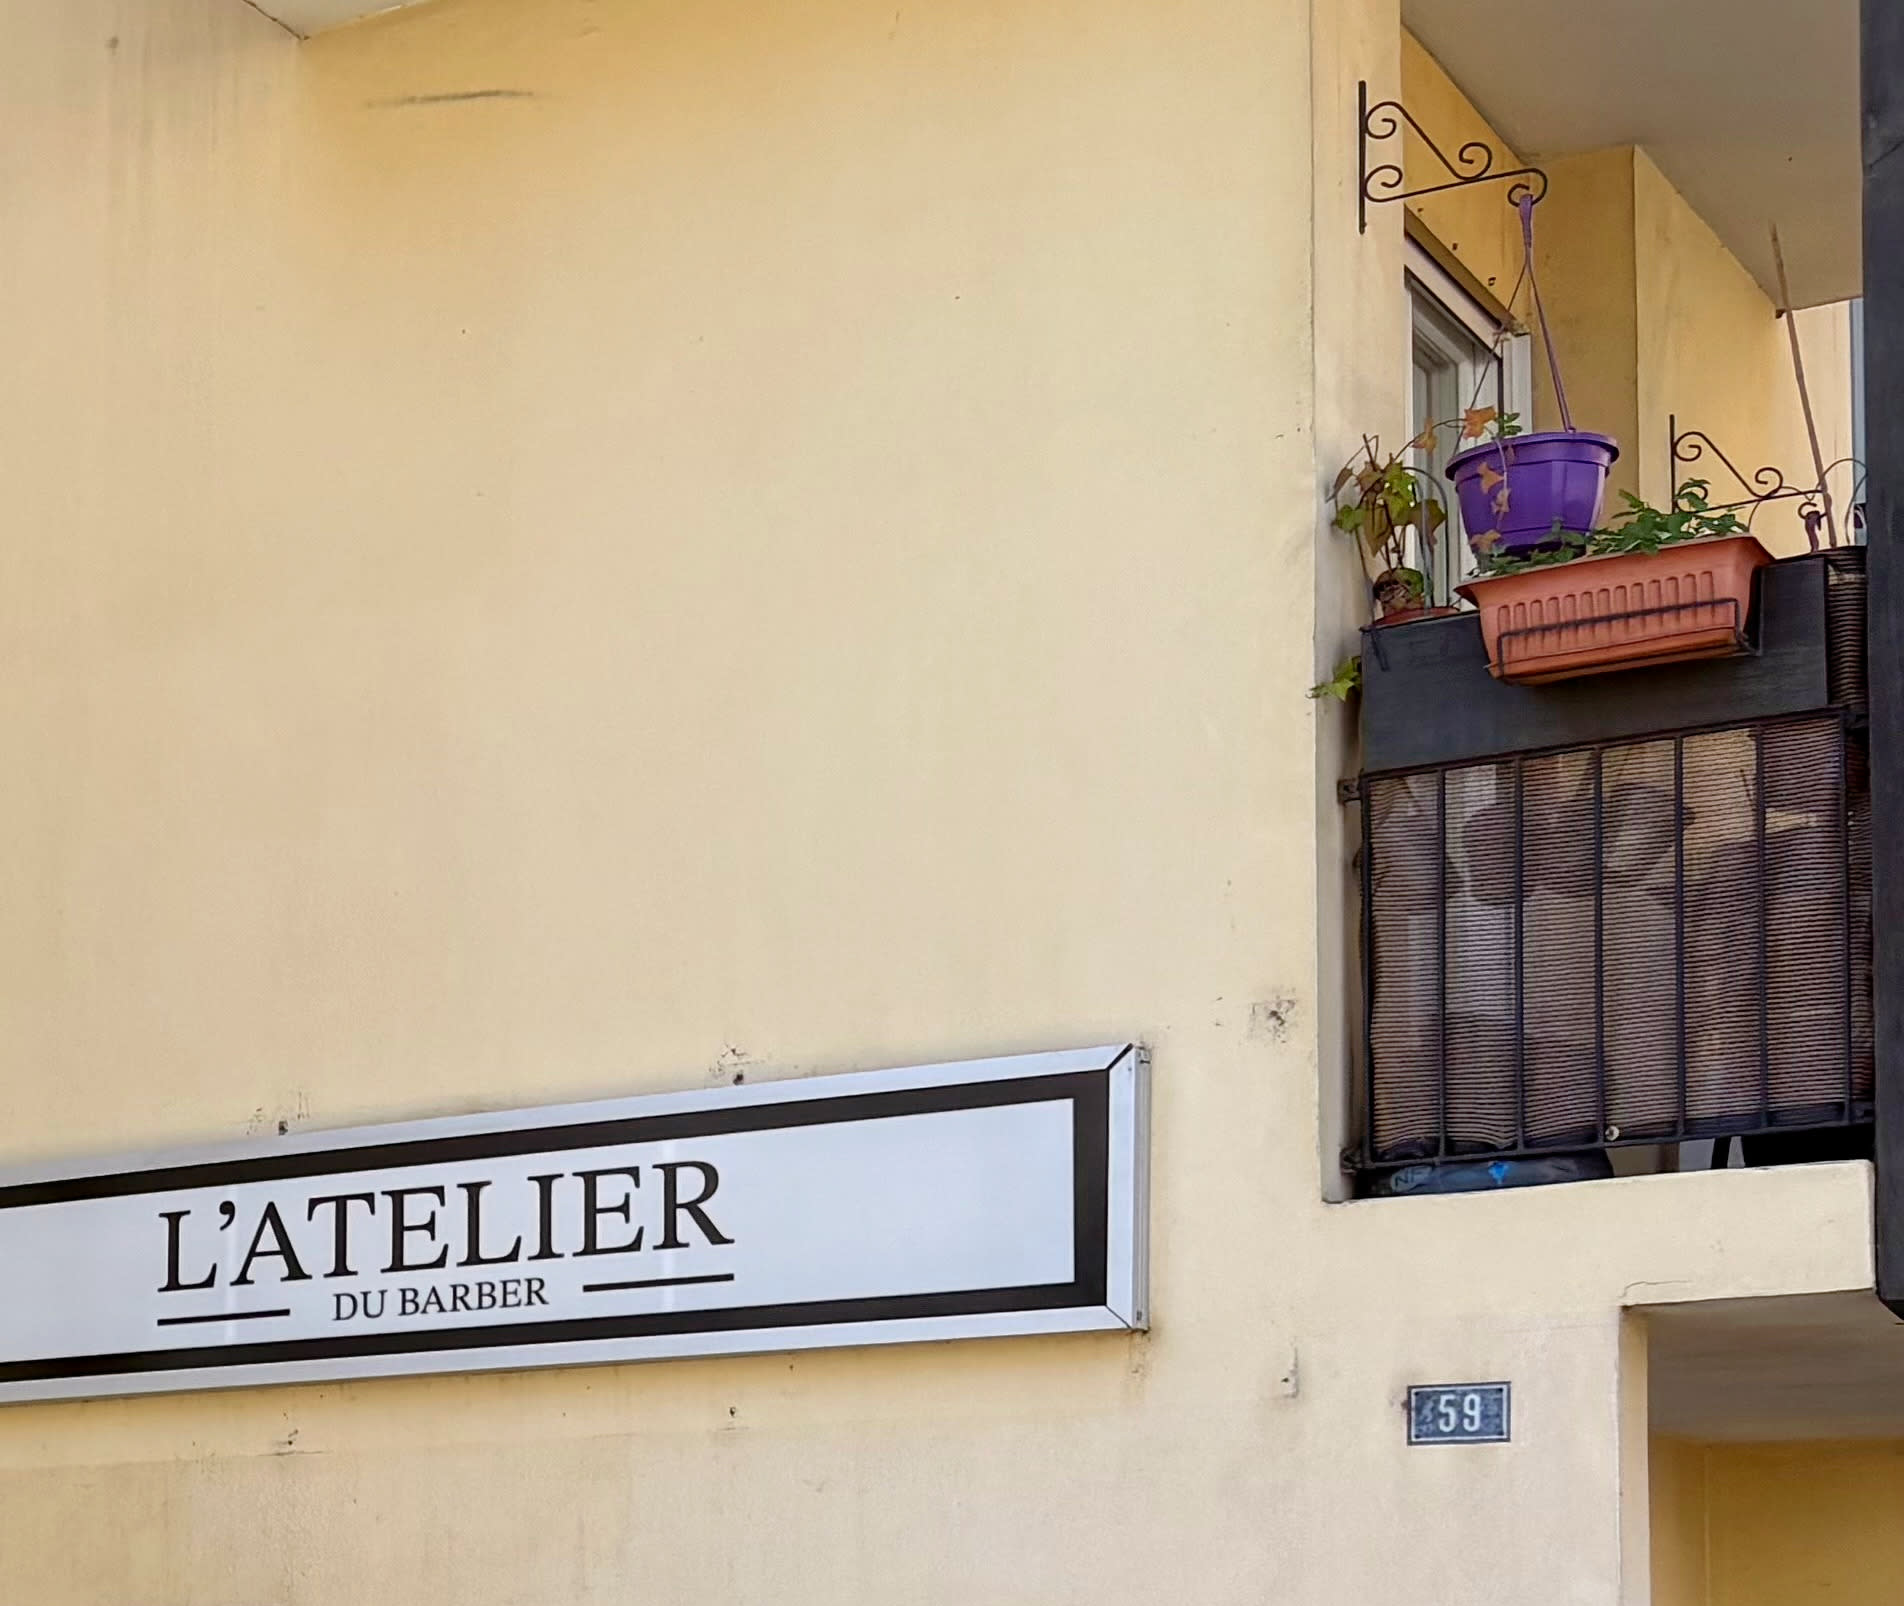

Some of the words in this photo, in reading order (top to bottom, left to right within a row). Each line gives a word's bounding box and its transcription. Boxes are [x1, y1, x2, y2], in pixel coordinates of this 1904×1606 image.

[157, 1161, 735, 1293] L'ATELIER
[332, 1290, 391, 1322] DU
[397, 1277, 549, 1315] BARBER
[1439, 1393, 1481, 1432] 59
